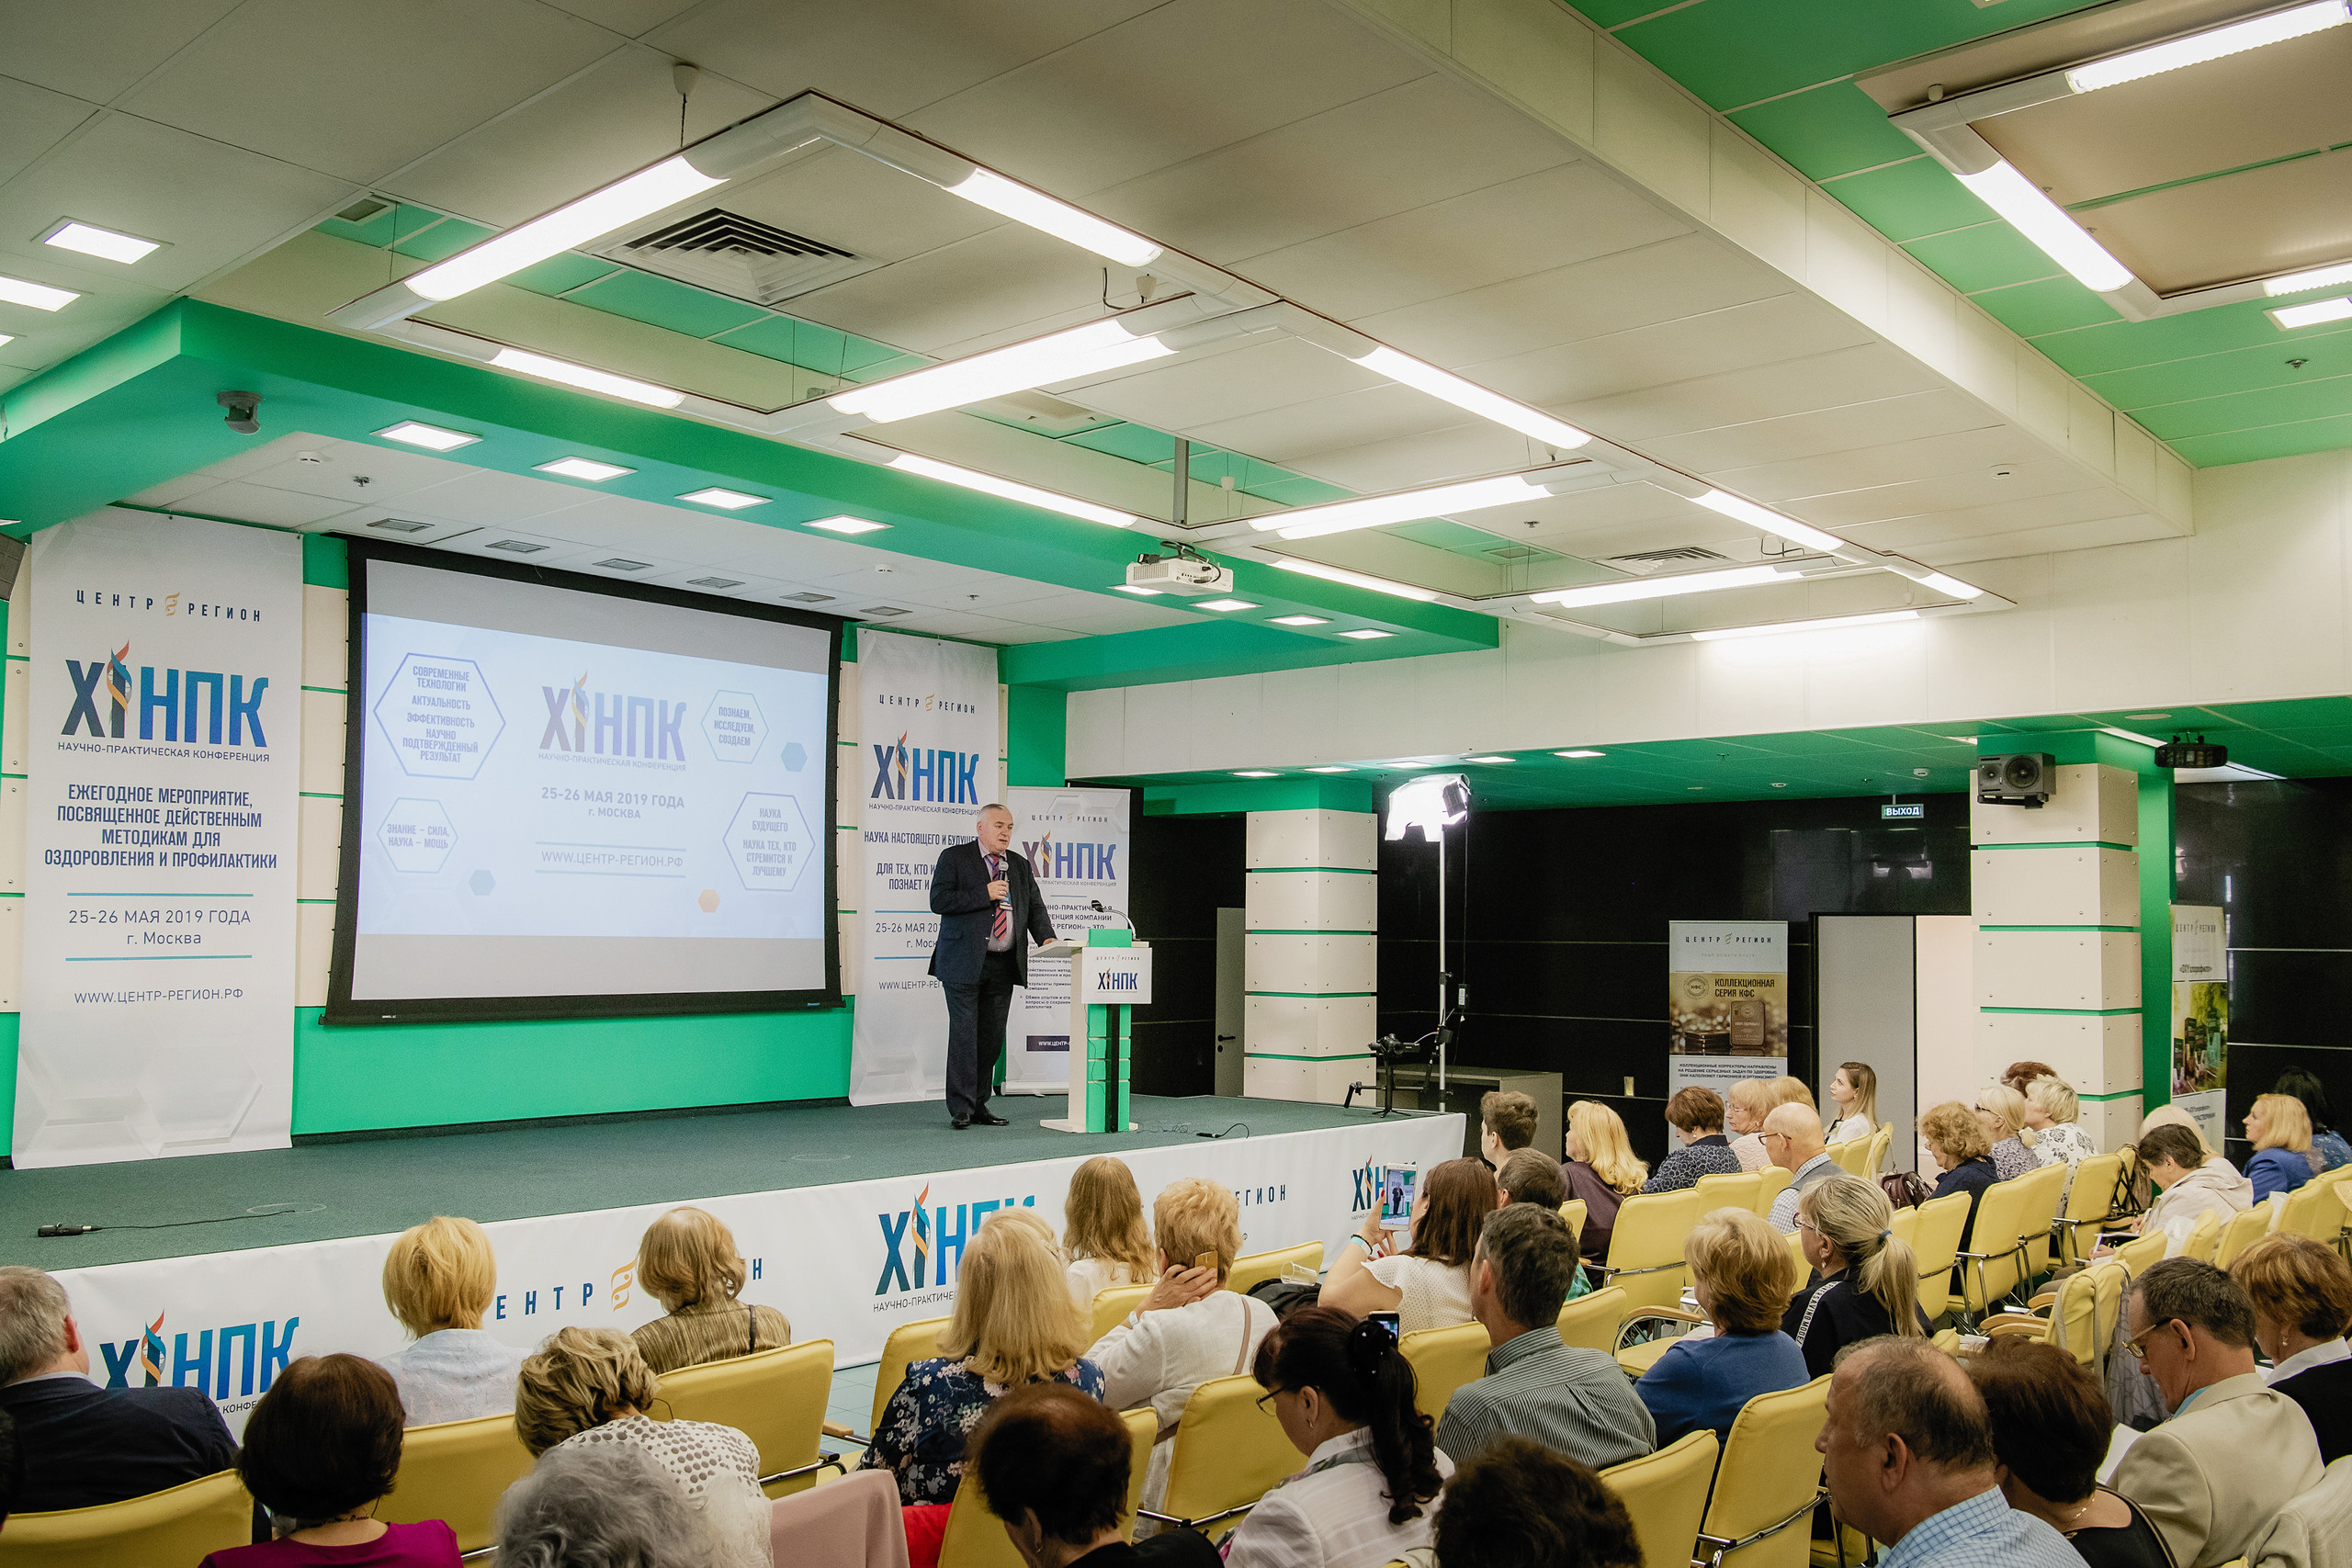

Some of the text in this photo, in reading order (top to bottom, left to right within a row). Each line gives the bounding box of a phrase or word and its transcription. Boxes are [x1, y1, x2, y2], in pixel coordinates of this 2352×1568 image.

[76, 590, 261, 622] ЦЕНТР РЕГИОН
[413, 666, 469, 682] СОВРЕМЕННЫЕ
[417, 677, 467, 692] ТЕХНОЛОГИИ
[412, 695, 470, 710] АКТУАЛЬНОСТЬ
[879, 694, 975, 714] ЦЕНТР РЕГИОН
[718, 706, 752, 719] ПОЗНАЕМ,
[407, 713, 475, 728] ЭФФЕКТИВНОСТЬ
[714, 720, 755, 734] ИССЛЕДУЕМ,
[425, 728, 456, 740] НАУЧНО
[718, 734, 751, 746] СОЗДАЕМ
[58, 742, 270, 762] НАУЧНО-ПРАКТИЧЕСКАЯ КОНФЕРЕНЦИЯ
[402, 738, 479, 753] ПОДТВЕРЖДЕННЫЙ
[420, 750, 461, 762] РЕЗУЛЬТАТ
[538, 752, 686, 772] НАУЧНО-ПРАКТИЧЕСКАЯ КОНФЕРЕНЦИЯ
[68, 784, 253, 808] ЕЖЕГОДНОЕ МЕРОПРИЯТИЕ,
[541, 787, 684, 810] 25-26 МАЯ 2019 ГОДА
[597, 807, 641, 818] МОСКВА
[759, 807, 781, 818] НАУКА
[868, 803, 941, 813] НАУЧНО-ПРАКТИЧЕСКАЯ
[1886, 807, 1920, 816] ВЫХОД
[57, 806, 262, 827] ПОСВЯЩЕННОЕ ДЕЙСТВЕННЫМ
[387, 824, 416, 835] ЗНАНИЕ
[427, 826, 449, 837] СИЛА,
[752, 820, 788, 832] БУДУЩЕГО
[102, 829, 220, 849] МЕТОДИКАМ ДЛЯ
[389, 837, 413, 847] НАУКА
[424, 838, 448, 850] МОЩЬ
[864, 831, 888, 843] НАУКА
[891, 832, 940, 846] НАСТОЯЩЕГО
[942, 834, 946, 845] И
[742, 839, 797, 852] НАУКА ТЕХ, КТО
[44, 849, 277, 868] ОЗДОРОВЛЕНИЯ И ПРОФИЛАКТИКИ
[541, 851, 683, 867] WWW.ЦЕНТР-РЕГИОН.РФ
[746, 852, 792, 863] СТРЕМИТСЯ К
[752, 865, 786, 876] ЛУЧШЕМУ
[876, 863, 893, 875] ДЛЯ
[896, 863, 911, 876] ТЕХ,
[914, 864, 928, 875] КТО
[889, 879, 930, 890] ПОЗНАЕТ И
[69, 909, 252, 925] 25-26 МАЯ 2019 ГОДА
[876, 923, 902, 933] 25-26
[905, 922, 925, 932] МАЯ
[127, 931, 201, 944] г. Москва
[1714, 978, 1775, 987] КОЛЛЕКЦИОННАЯ
[74, 988, 243, 1003] WWW.ЦЕНТР-РЕГИОН.РФ
[1714, 989, 1755, 998] СЕРИЯ КФС
[496, 1282, 594, 1320] ЕНТР
